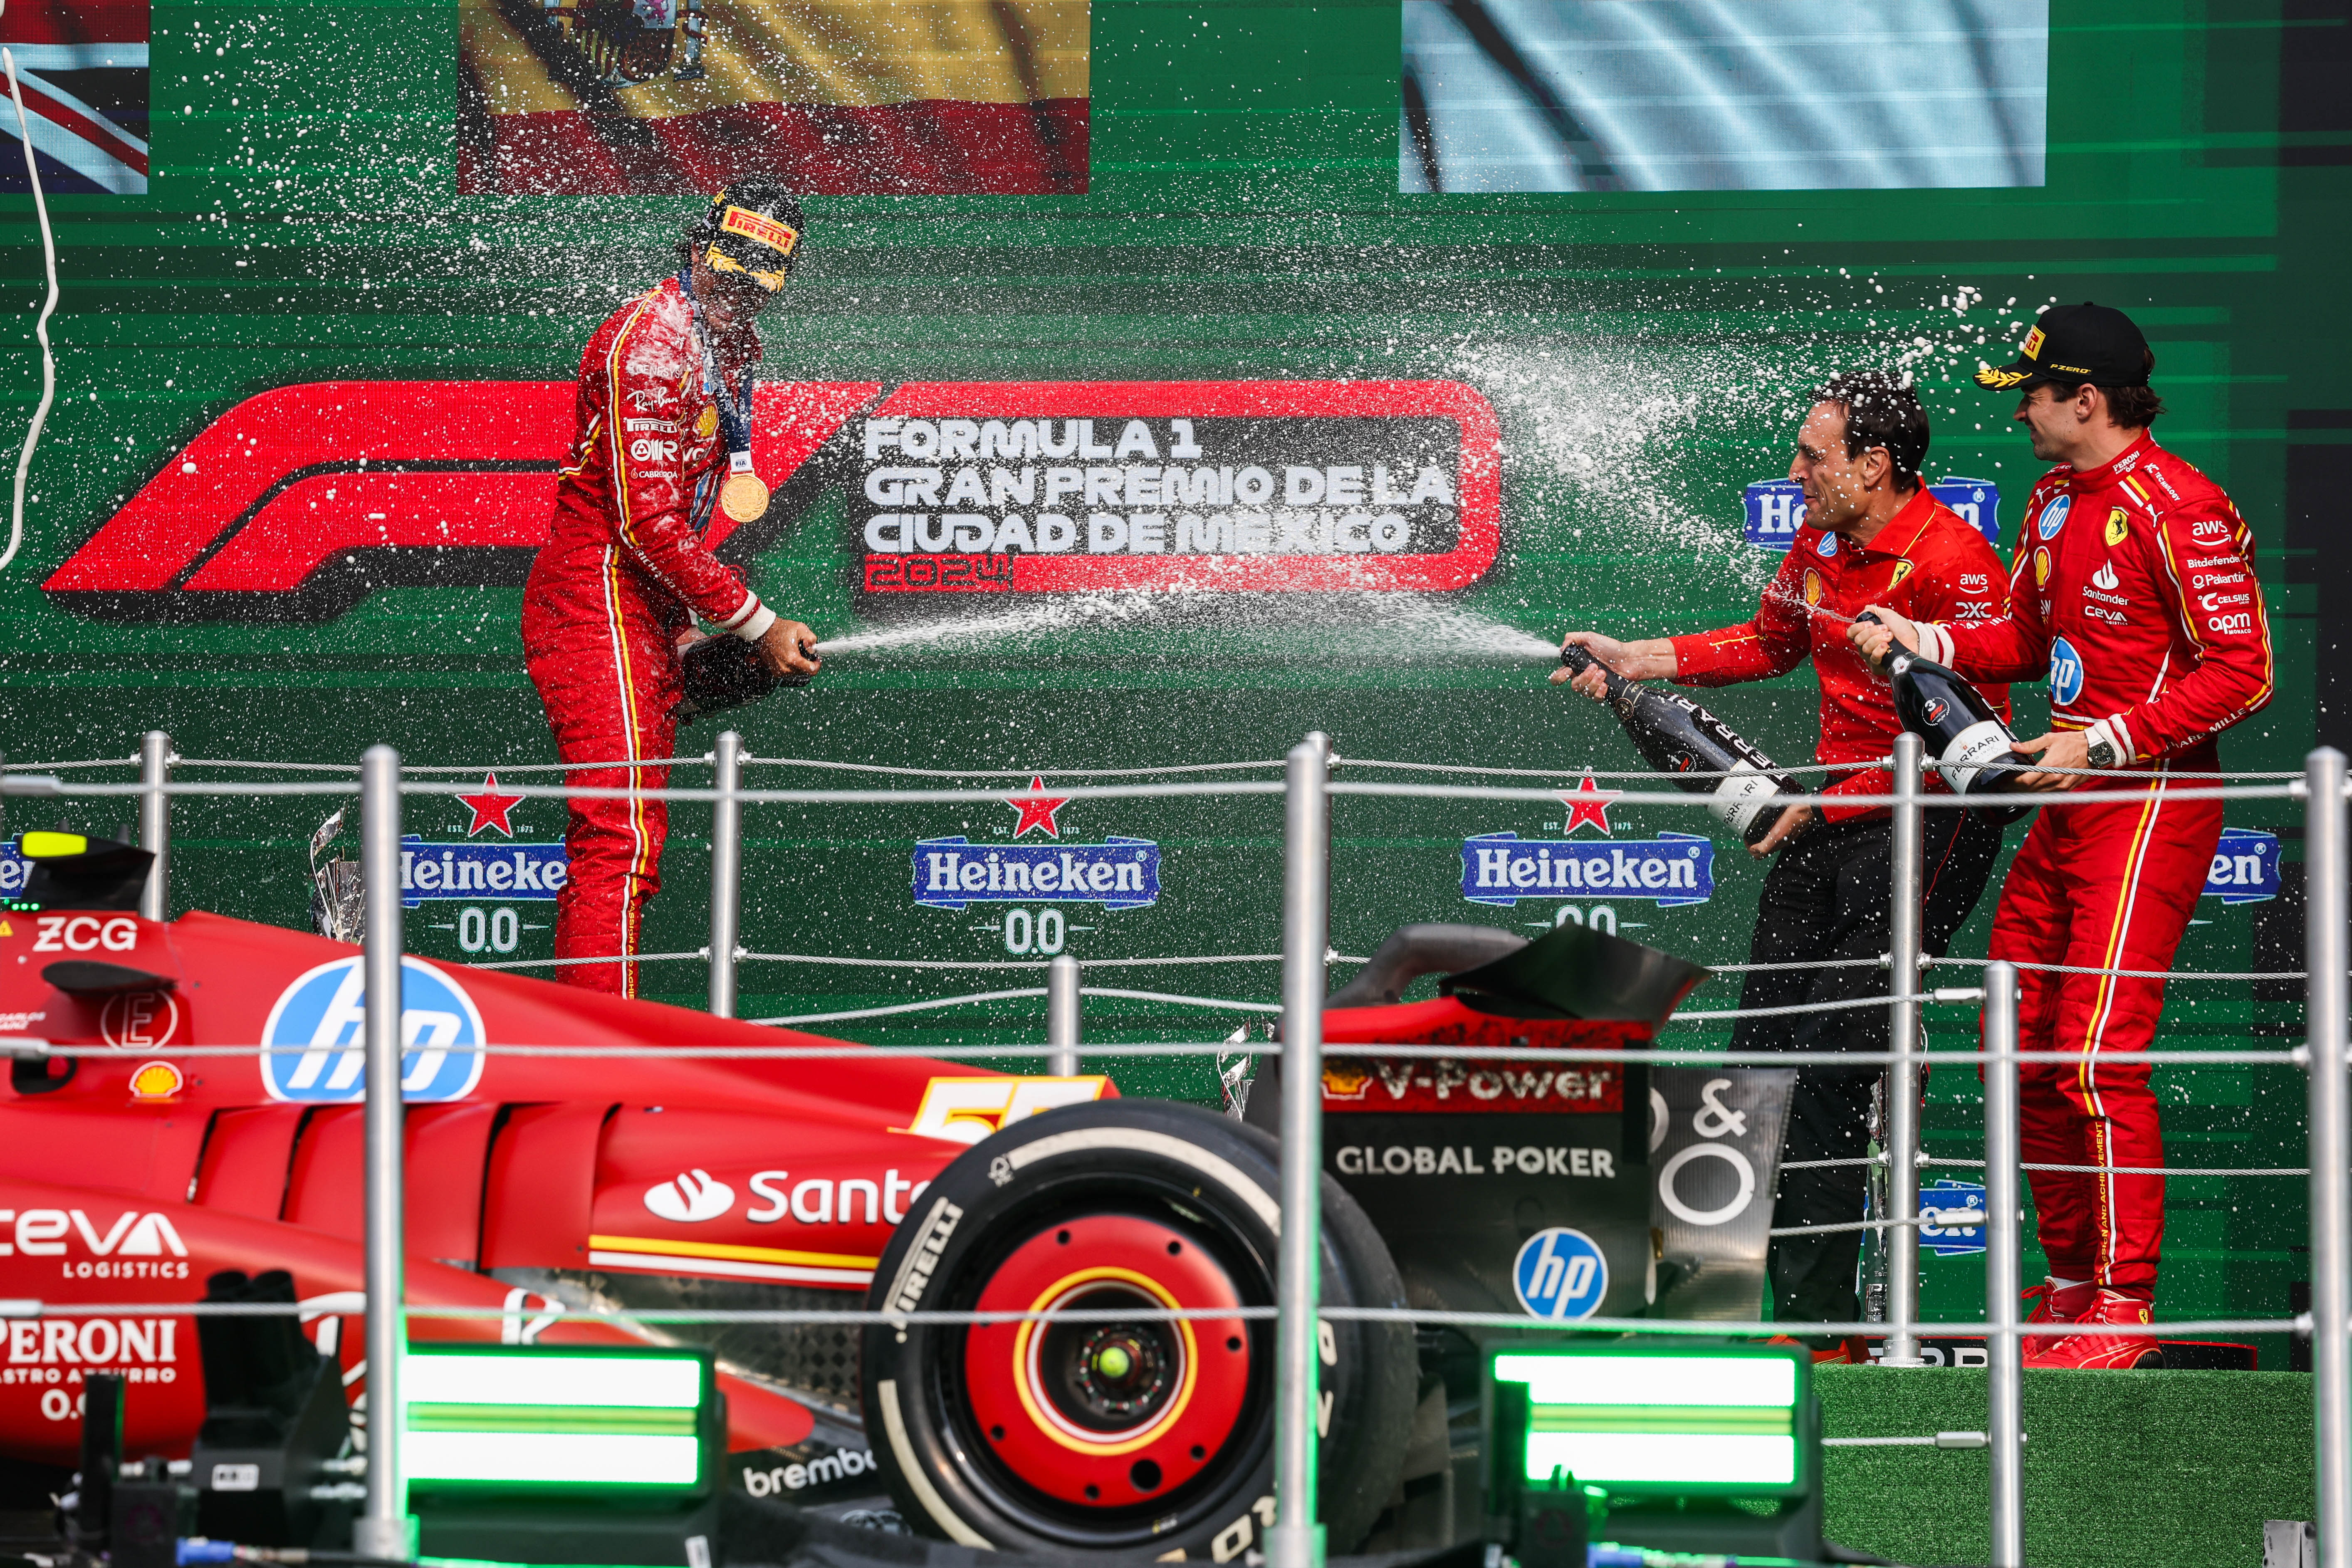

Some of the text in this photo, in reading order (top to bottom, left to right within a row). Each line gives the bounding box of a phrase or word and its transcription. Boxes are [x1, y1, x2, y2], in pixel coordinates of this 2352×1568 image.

[728, 210, 792, 248] PIRELLI
[626, 386, 679, 412] Ray-Ban
[626, 418, 678, 433] PIRELLI
[864, 418, 1202, 459] FORMULA 1
[2112, 450, 2140, 472] PERONI
[863, 466, 1453, 506] GRAN PREMIO DE LA
[2154, 471, 2181, 501] TECHNOLOGY
[863, 513, 1077, 553] CIUDAD
[1088, 513, 1165, 553] DE
[2042, 495, 2068, 539] hp
[2192, 520, 2228, 536] aws
[866, 555, 1012, 590] 2024
[2187, 554, 2241, 569] Bitdefender
[2205, 571, 2246, 586] Palantir
[635, 549, 707, 616] RICHARD MILLE
[1959, 574, 1988, 585] aws
[2082, 586, 2129, 606] Santander
[1955, 602, 1992, 618] DXC
[2218, 593, 2249, 604] CELSIUS
[2208, 613, 2251, 635] apm
[2209, 707, 2246, 733] MILLE
[993, 826, 1010, 834] EST.
[1543, 822, 1561, 831] EST.
[400, 851, 569, 891] Heineke
[926, 852, 1145, 892] Heineken
[1476, 848, 1698, 889] Heineken
[458, 906, 519, 953] 0.0
[1004, 908, 1065, 955] 0.0
[1375, 1057, 1611, 1100] V-Power
[1336, 1145, 1616, 1179] GLOBAL POKER
[2095, 1122, 2107, 1204] ACHIVEMENT
[747, 1169, 930, 1225] Sant
[0, 1209, 188, 1257] EVA
[63, 1261, 190, 1279] LOGISTICS
[881, 1197, 964, 1331] PIRELLI
[1526, 1230, 1598, 1319] hp
[0, 1318, 177, 1364] ERONI
[0, 1367, 62, 1385] STRO
